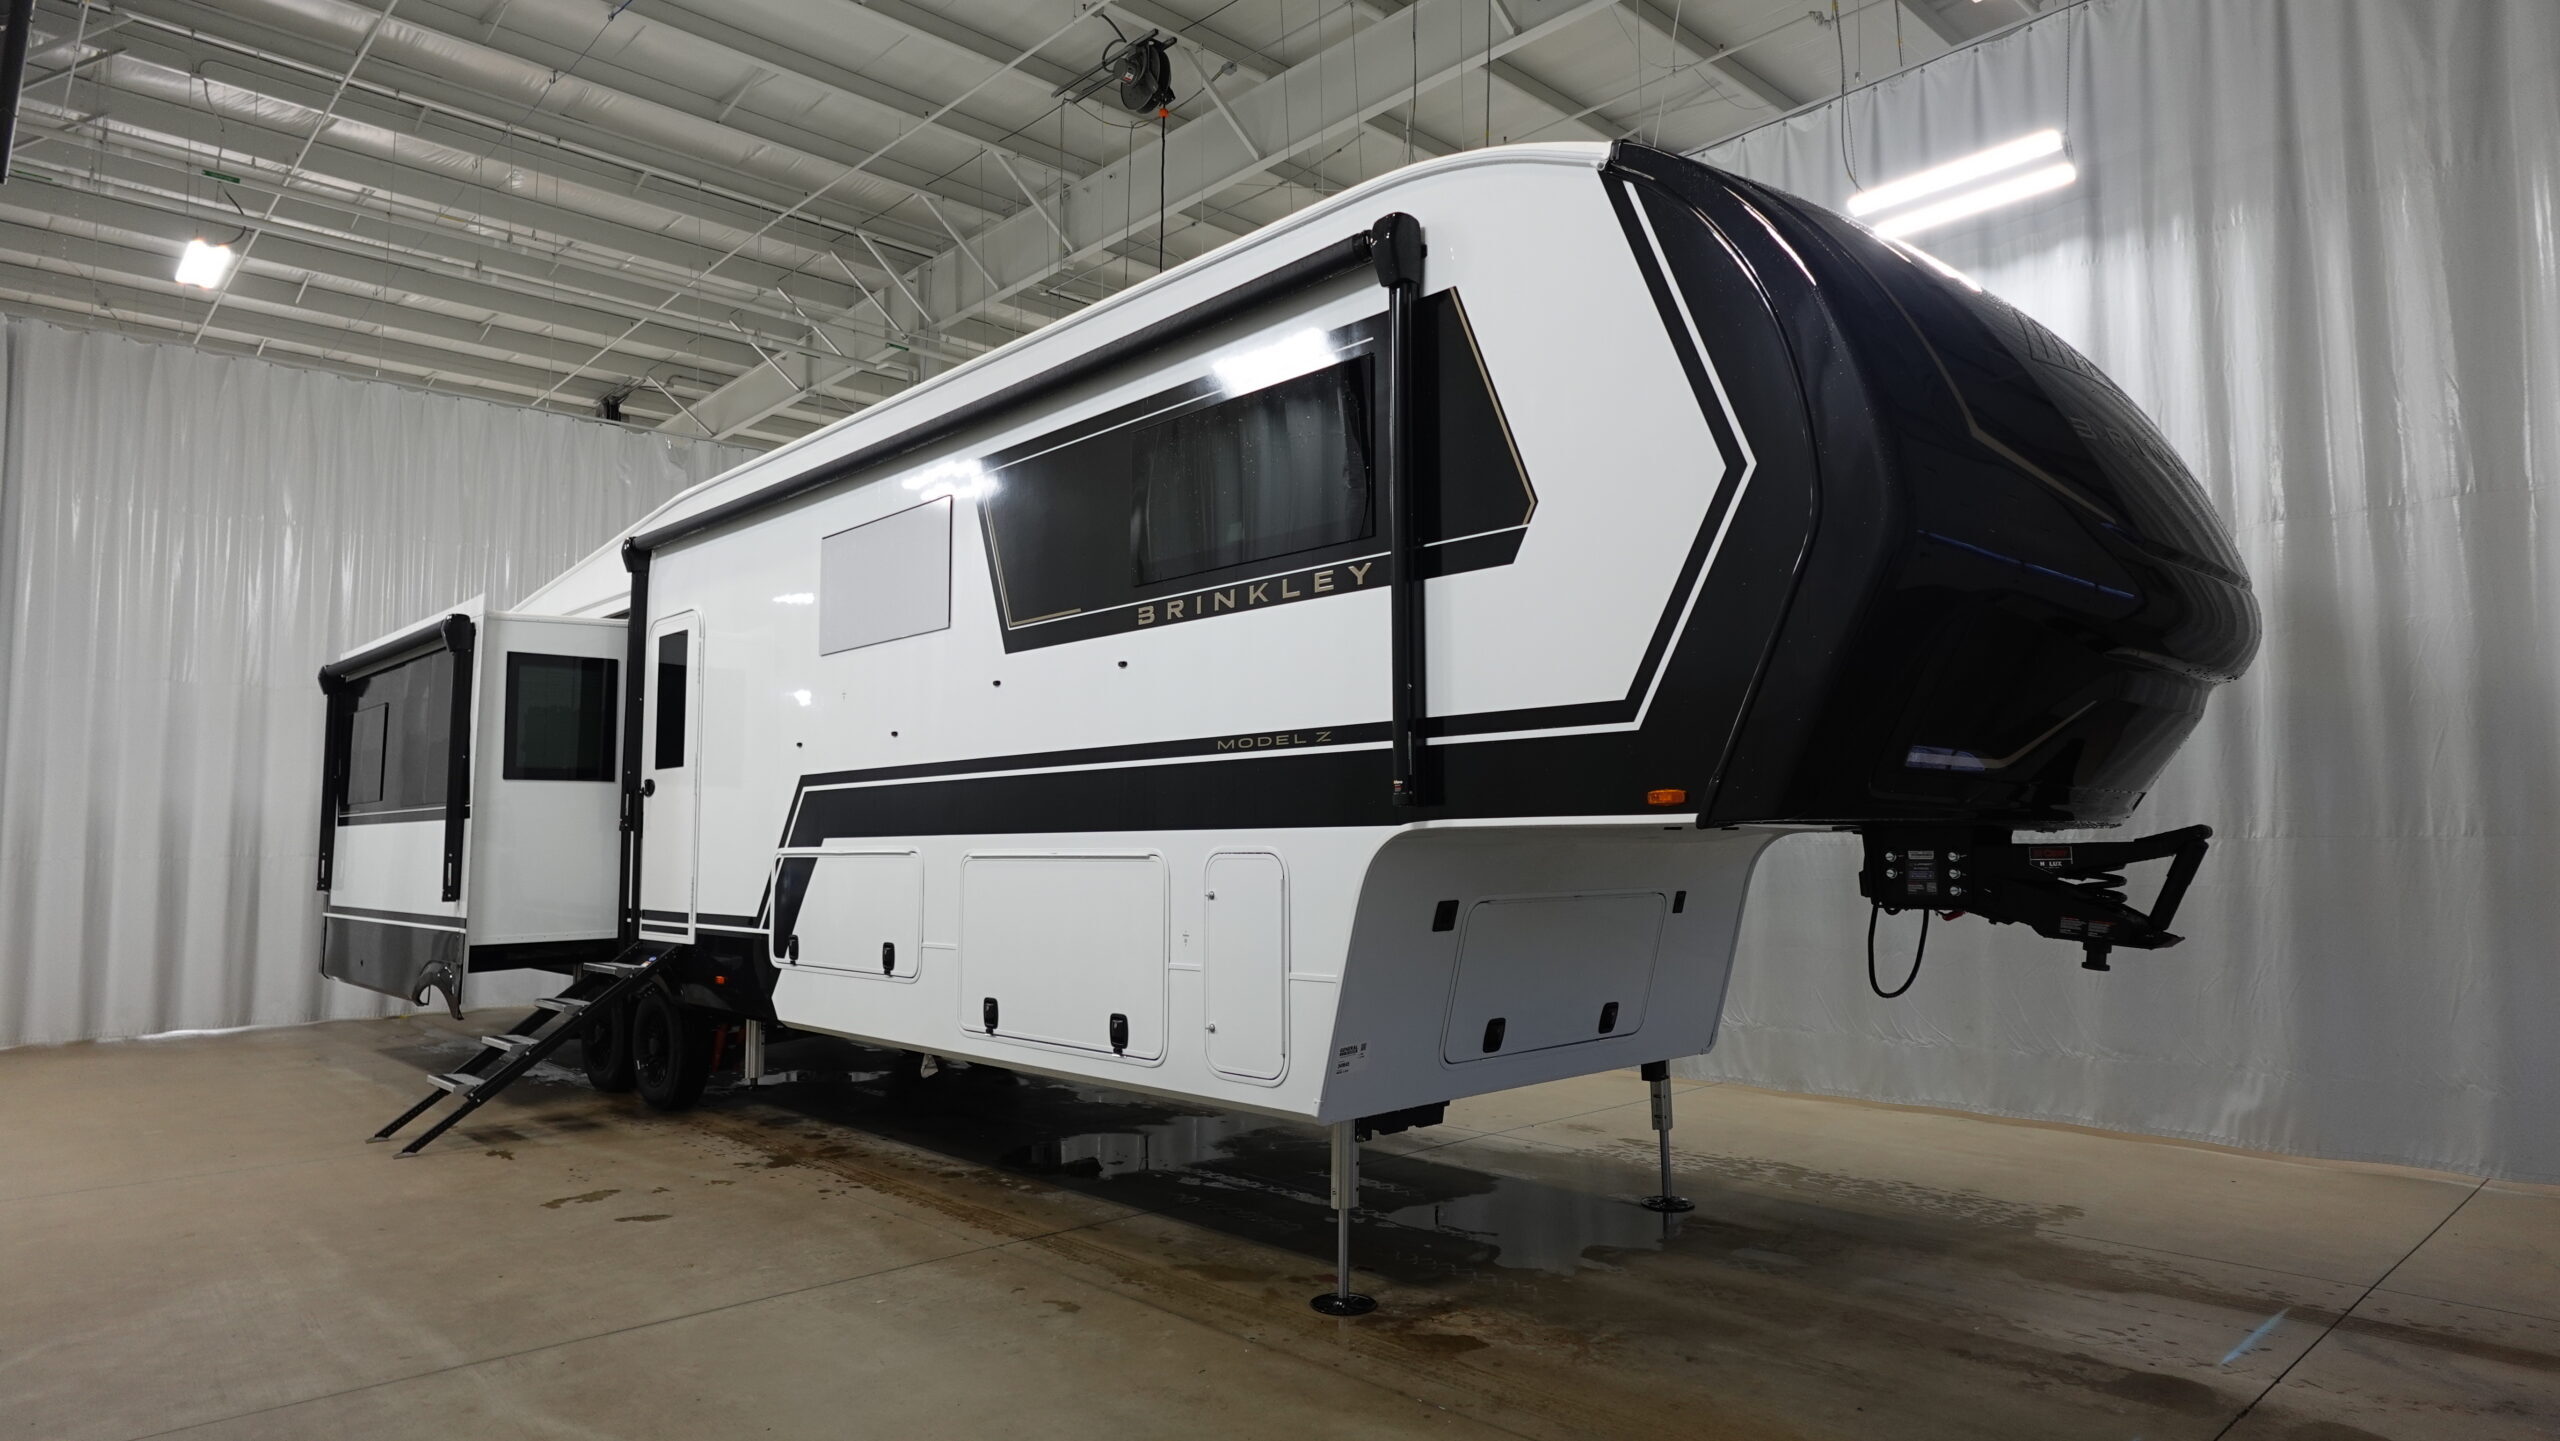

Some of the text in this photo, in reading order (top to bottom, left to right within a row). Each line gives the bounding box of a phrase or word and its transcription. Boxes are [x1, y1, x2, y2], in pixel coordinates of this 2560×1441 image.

[1138, 562, 1372, 626] BRINKLEY
[1217, 731, 1332, 751] MODEL Z
